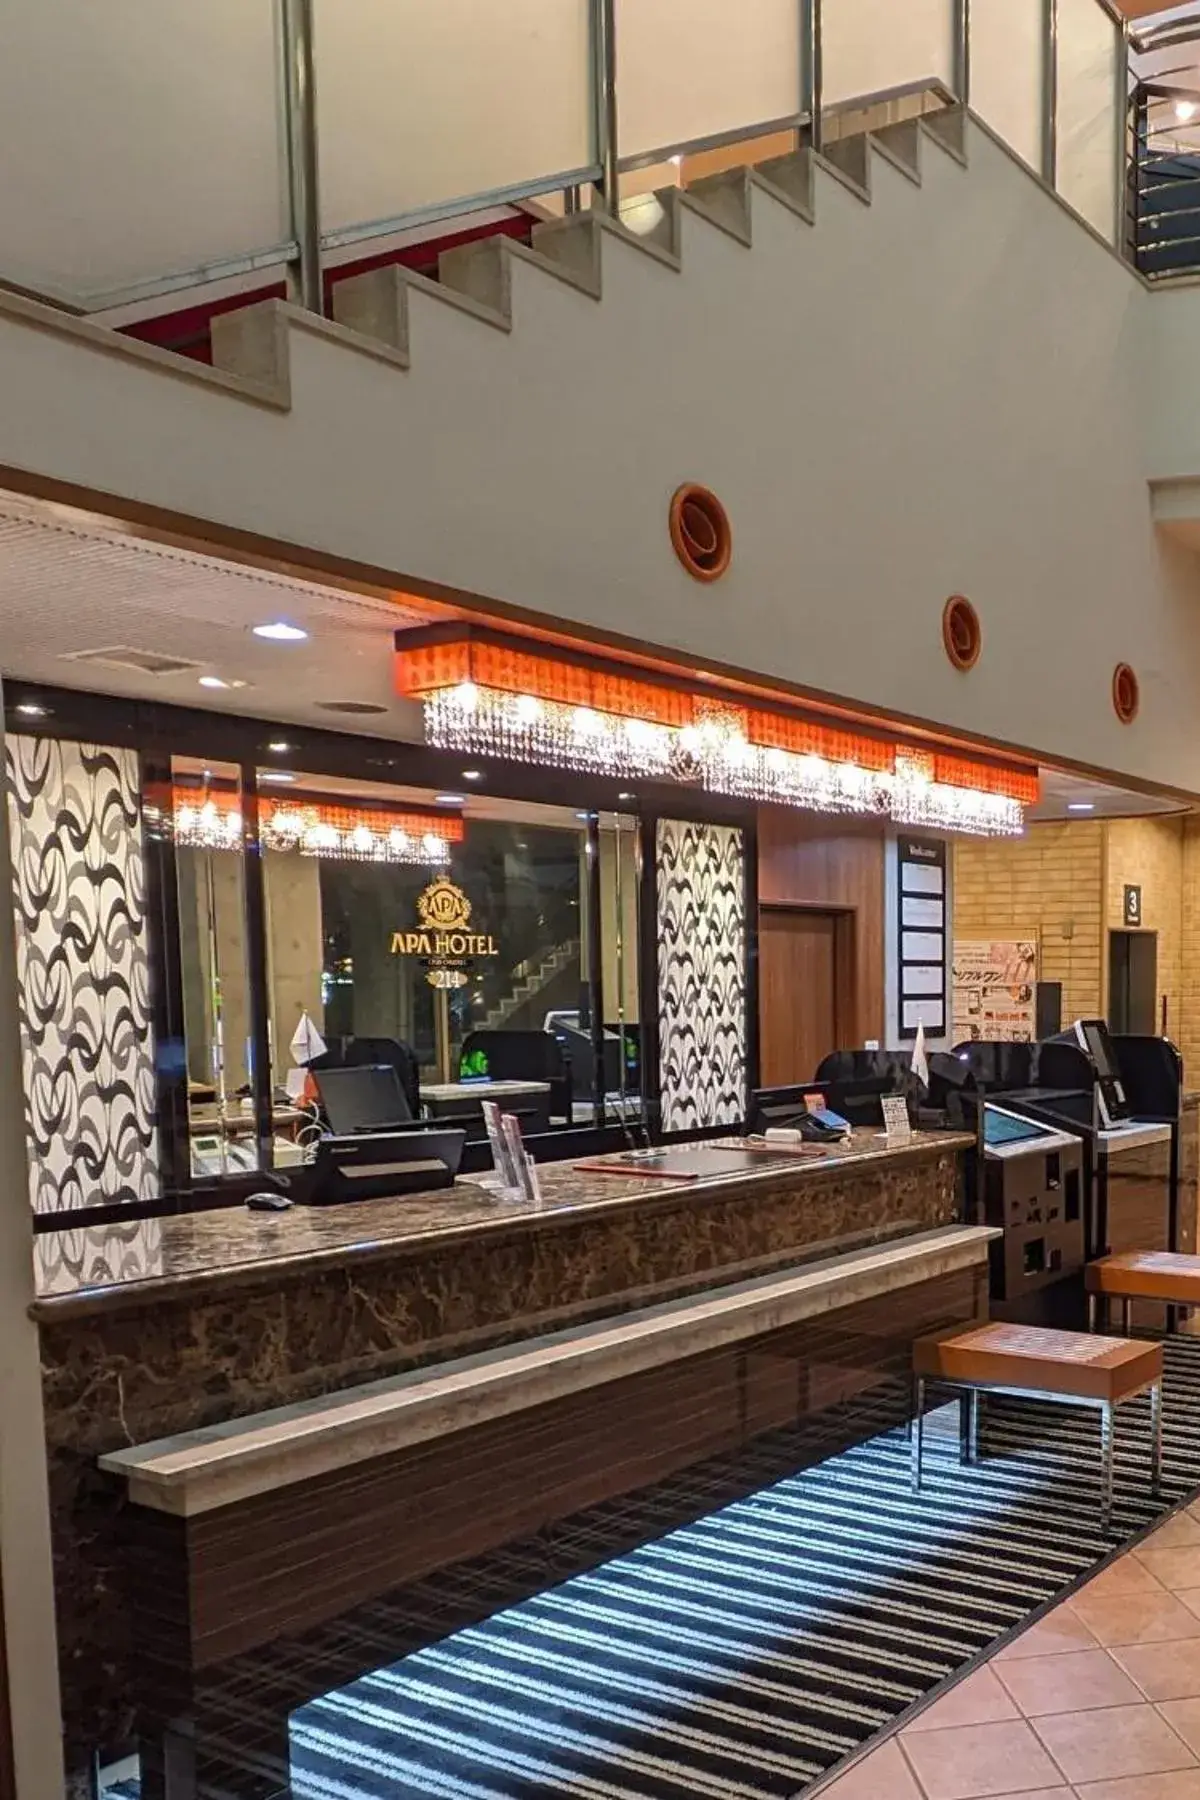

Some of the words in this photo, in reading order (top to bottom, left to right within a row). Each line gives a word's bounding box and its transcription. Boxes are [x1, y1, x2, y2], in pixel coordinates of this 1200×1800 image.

[428, 896, 462, 915] APA
[1129, 891, 1137, 914] 3
[391, 933, 432, 954] APA
[436, 935, 499, 955] HOTEL
[435, 971, 461, 989] 214
